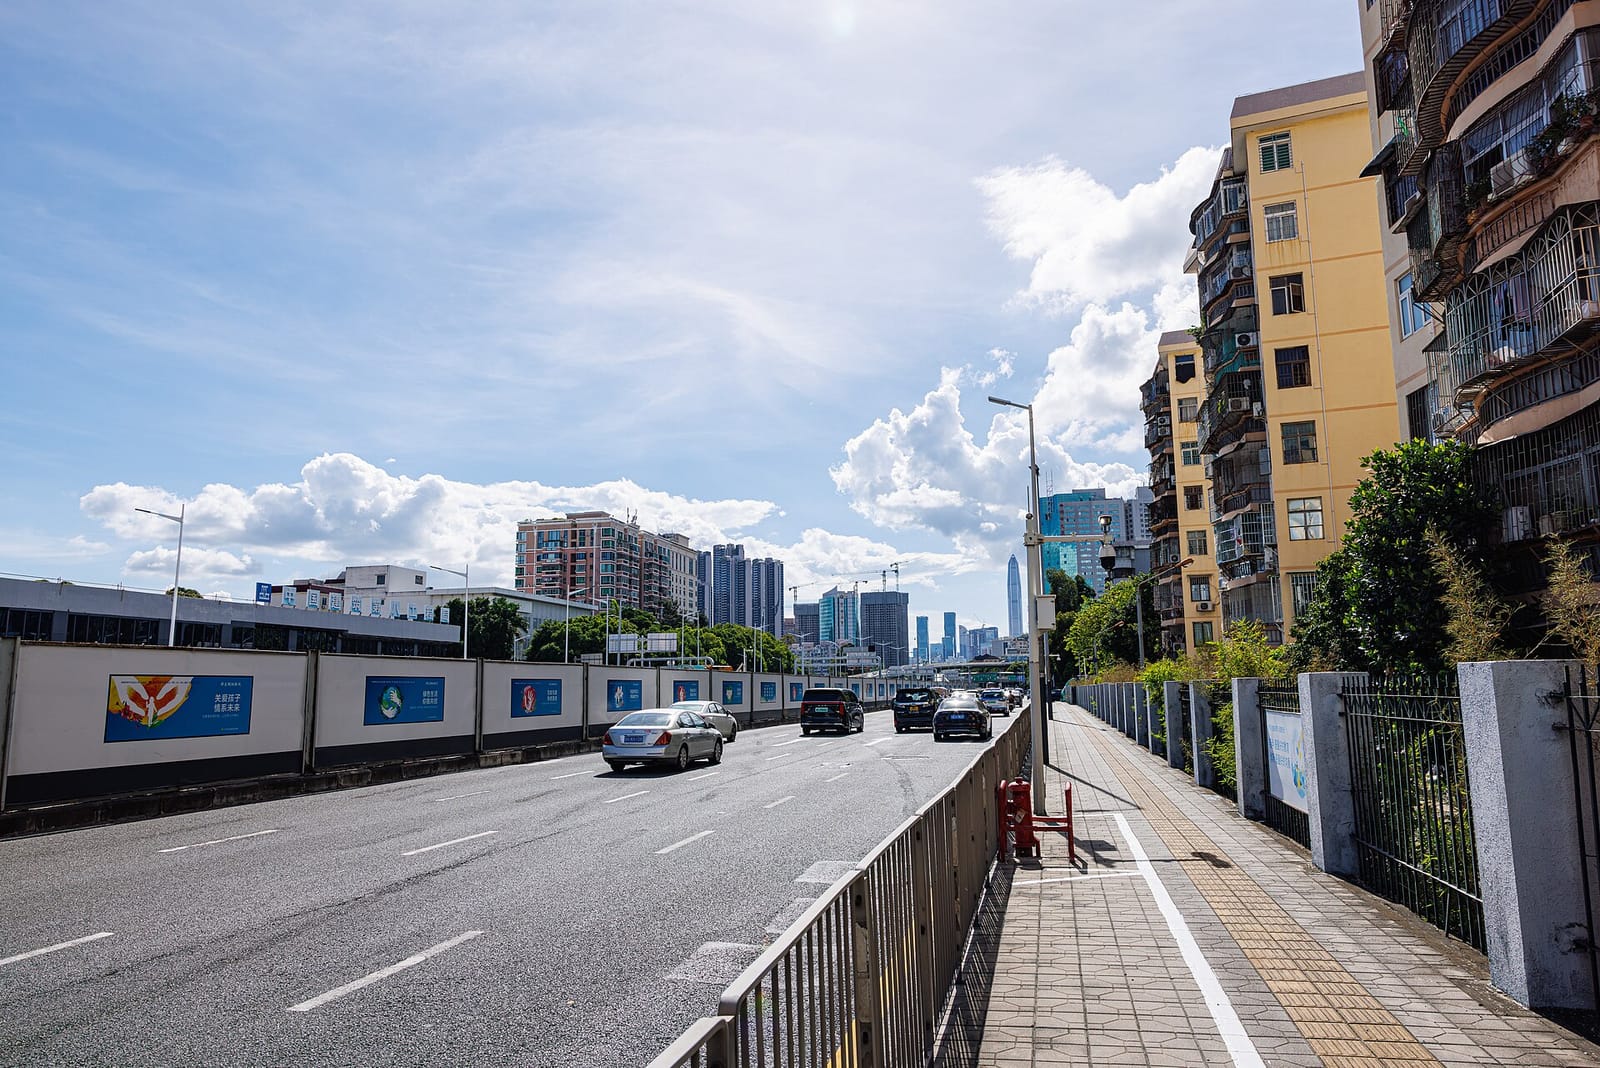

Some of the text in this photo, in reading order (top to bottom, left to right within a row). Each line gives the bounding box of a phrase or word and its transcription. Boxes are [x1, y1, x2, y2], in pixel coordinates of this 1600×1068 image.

[214, 693, 241, 703] 关爱孩子
[214, 703, 241, 713] 情系未来
